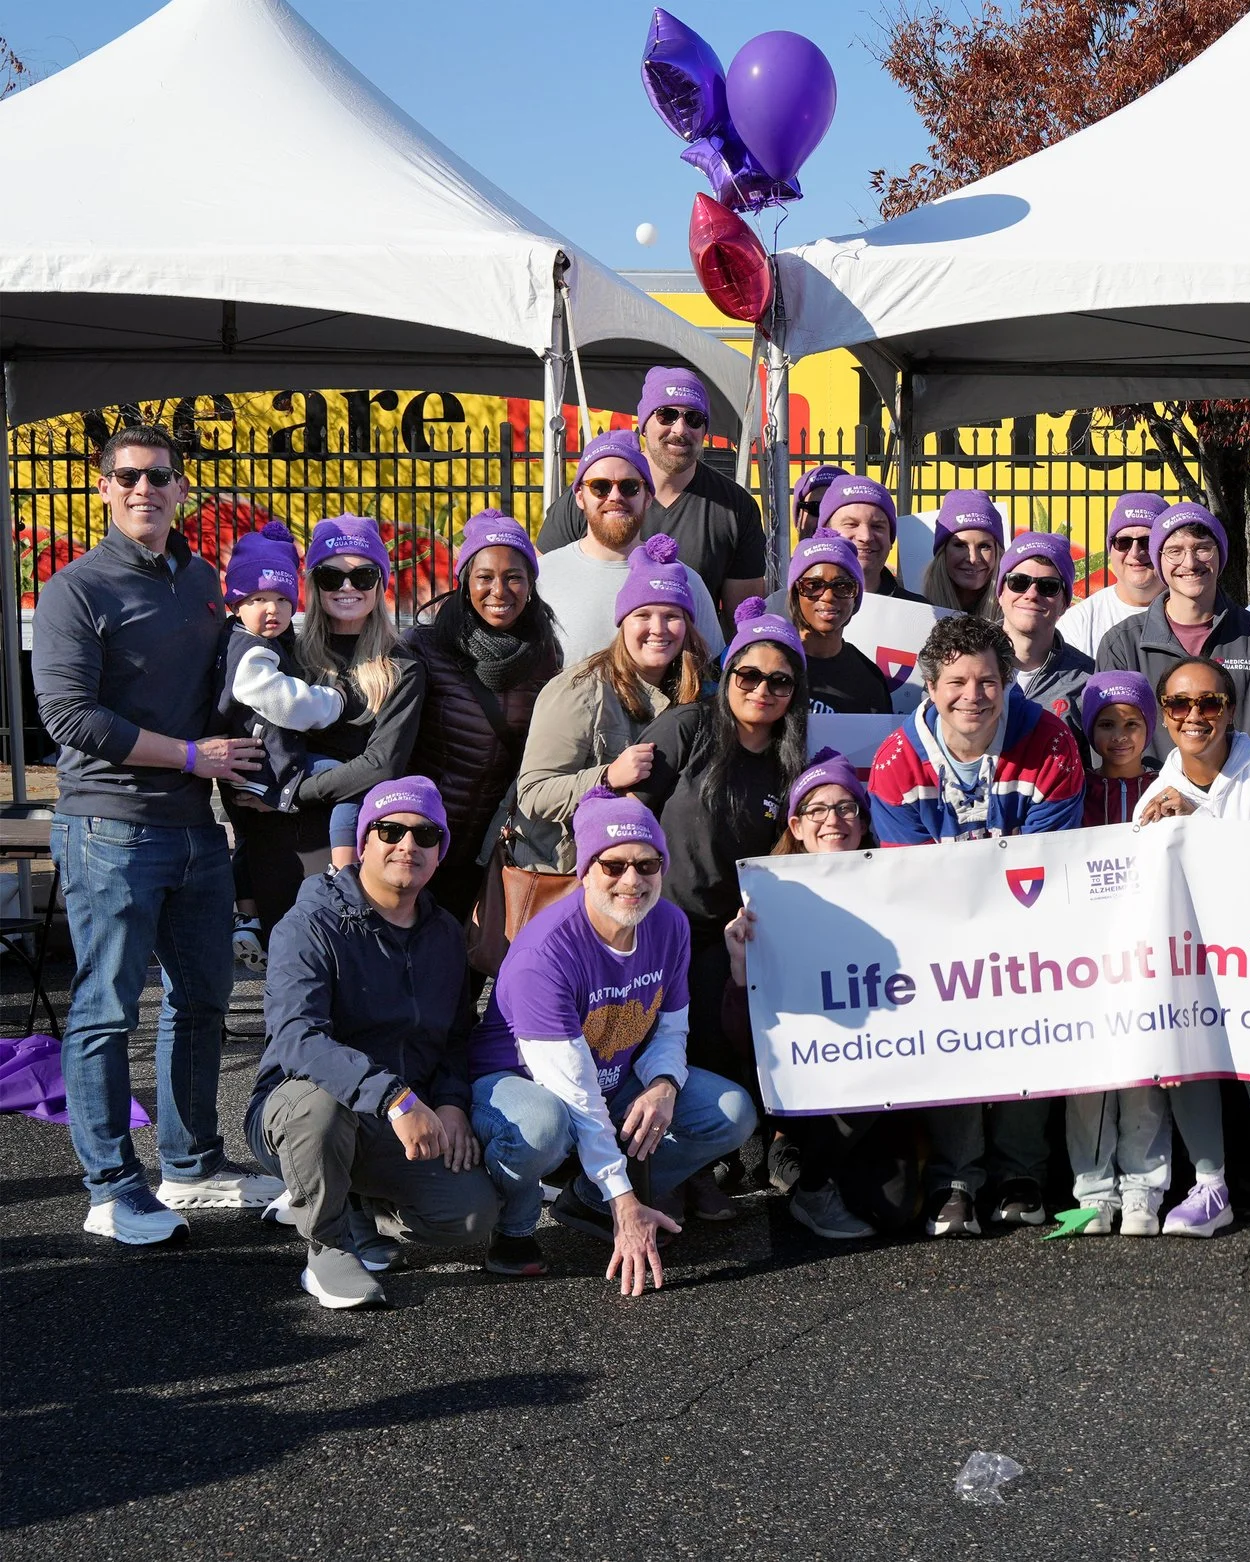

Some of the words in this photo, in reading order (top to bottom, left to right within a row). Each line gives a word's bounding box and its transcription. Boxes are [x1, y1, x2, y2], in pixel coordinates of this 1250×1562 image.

[272, 389, 466, 463] are
[335, 539, 369, 549] GUARDIAN
[1086, 856, 1137, 873] WALK
[1103, 870, 1140, 885] END
[1090, 882, 1141, 894] ALZHEIMS
[633, 968, 663, 989] NOW
[821, 963, 917, 1012] Life
[930, 939, 1157, 1003] Without
[791, 1028, 925, 1066] Medical
[936, 1017, 1095, 1054] Guardian
[1105, 1003, 1190, 1037] Walks
[1191, 999, 1231, 1028] for
